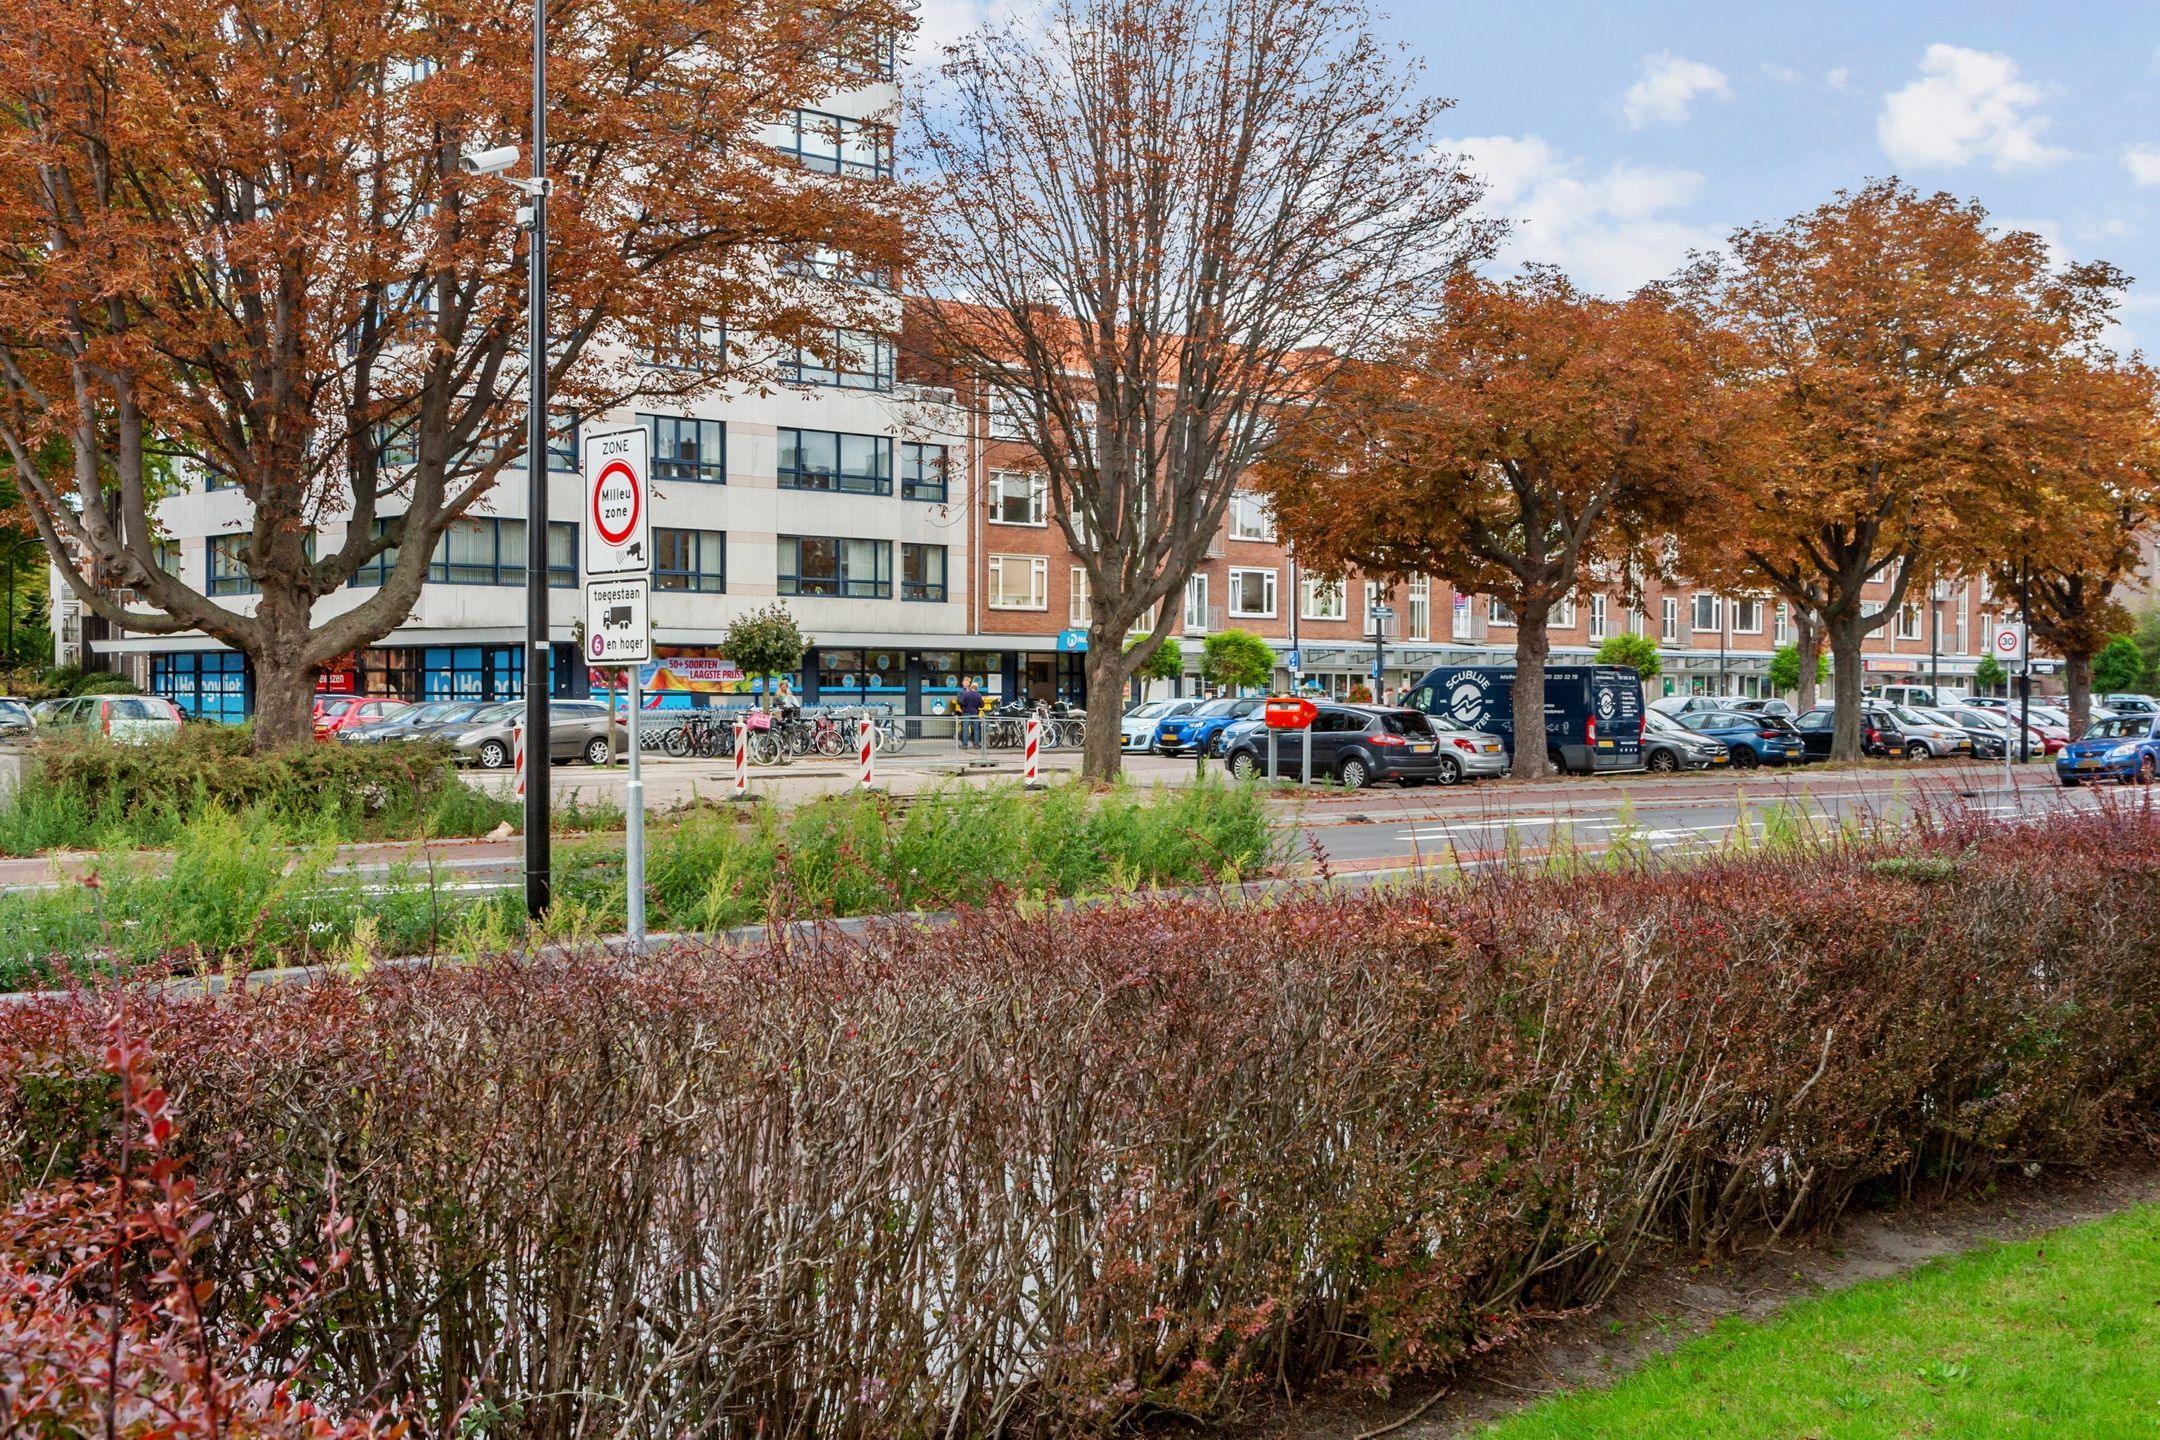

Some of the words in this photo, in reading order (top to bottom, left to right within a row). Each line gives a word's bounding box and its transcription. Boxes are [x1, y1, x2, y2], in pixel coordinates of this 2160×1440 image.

[602, 439, 629, 455] ZONE
[601, 489, 631, 502] Milieu
[605, 506, 628, 519] zone
[593, 588, 641, 604] toegestaan
[594, 638, 601, 649] 6
[606, 639, 617, 650] en
[619, 636, 644, 653] hoger
[2001, 637, 2014, 646] 30
[669, 659, 684, 669] 50+
[684, 660, 718, 669] SOORTEN
[689, 670, 721, 679] LAAGSTE
[1445, 670, 1491, 690] SCUBLUE
